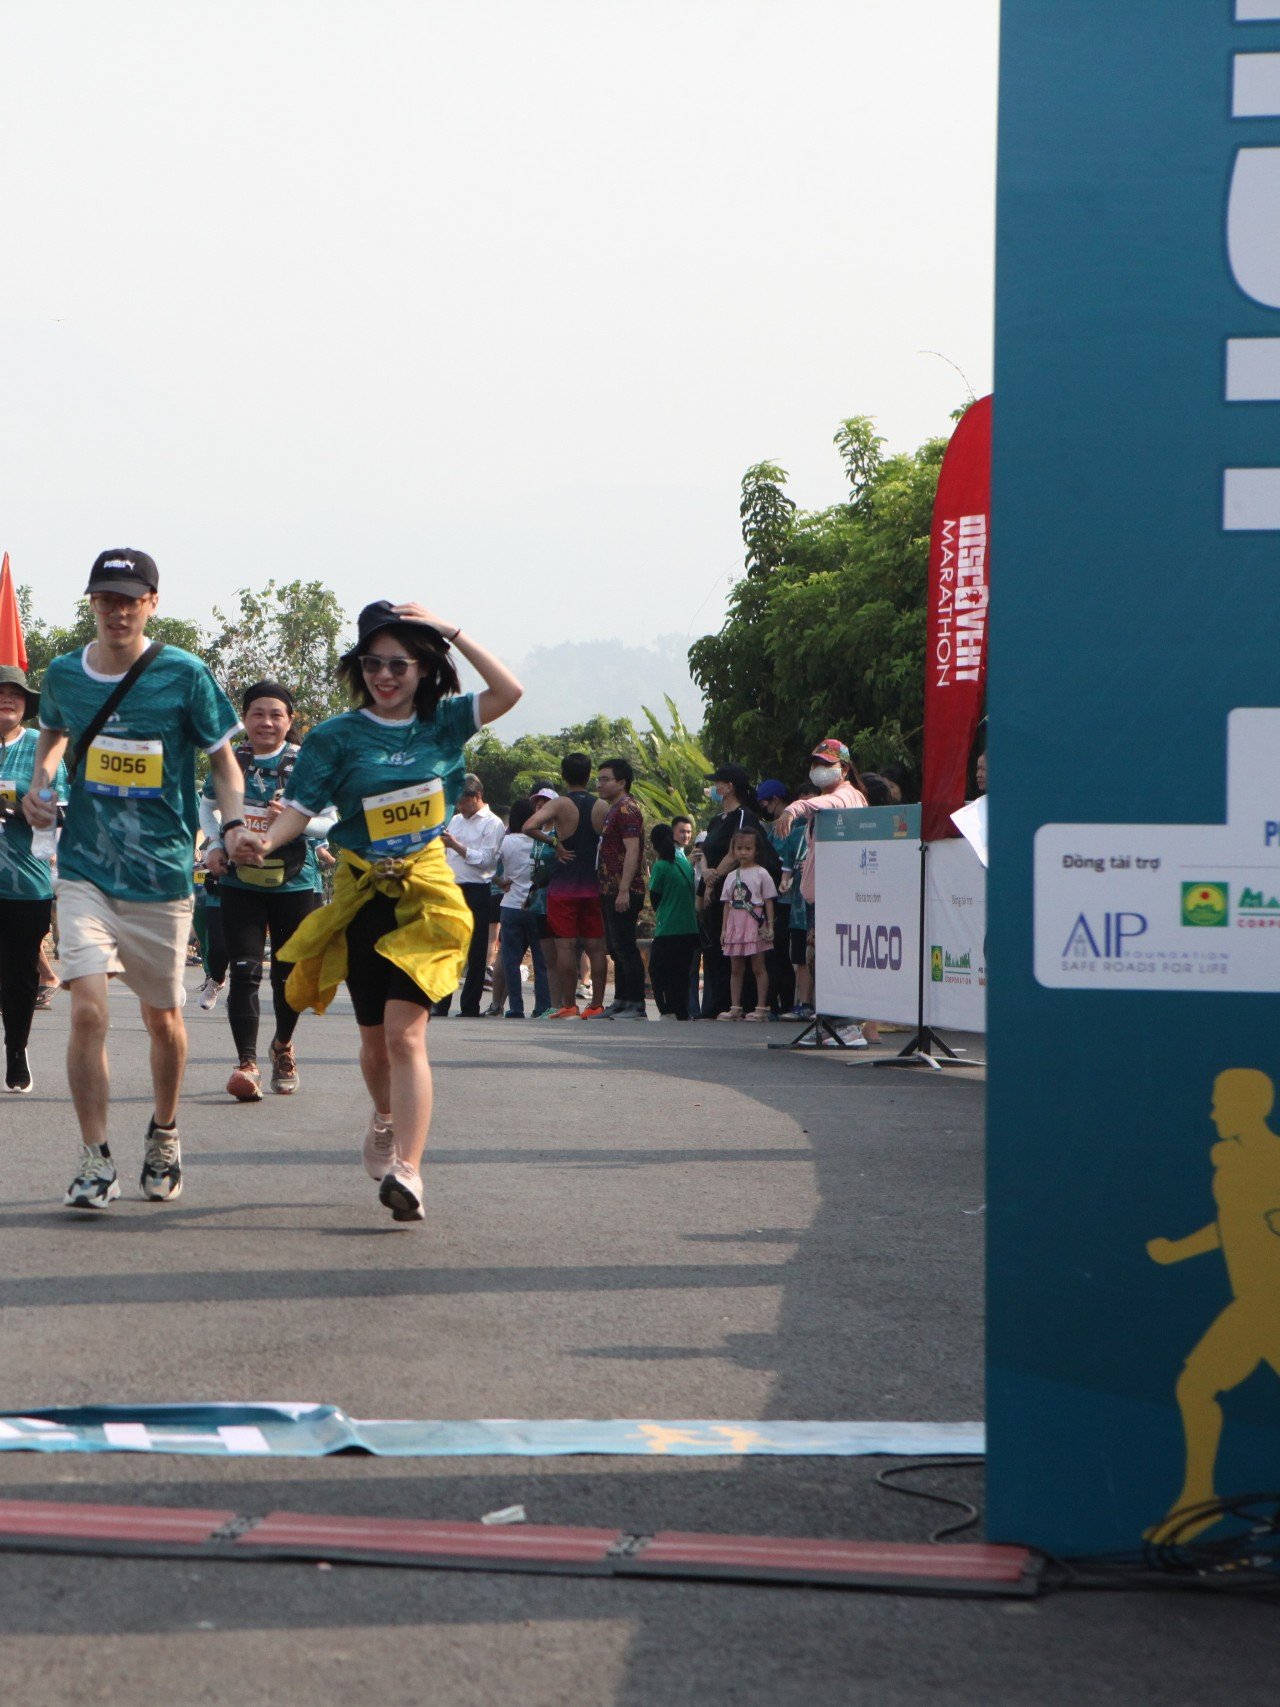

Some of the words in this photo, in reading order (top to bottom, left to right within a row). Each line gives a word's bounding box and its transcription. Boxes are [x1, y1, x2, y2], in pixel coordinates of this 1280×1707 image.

[935, 519, 957, 688] MARATHON
[100, 754, 146, 774] 9056
[382, 800, 430, 824] 9047
[835, 923, 903, 971] THACO
[1061, 912, 1148, 959] AIP
[1061, 961, 1096, 972] SAFE
[1103, 961, 1156, 973] ROADS
[1162, 962, 1194, 974] FOR
[1199, 962, 1229, 974] LIFE
